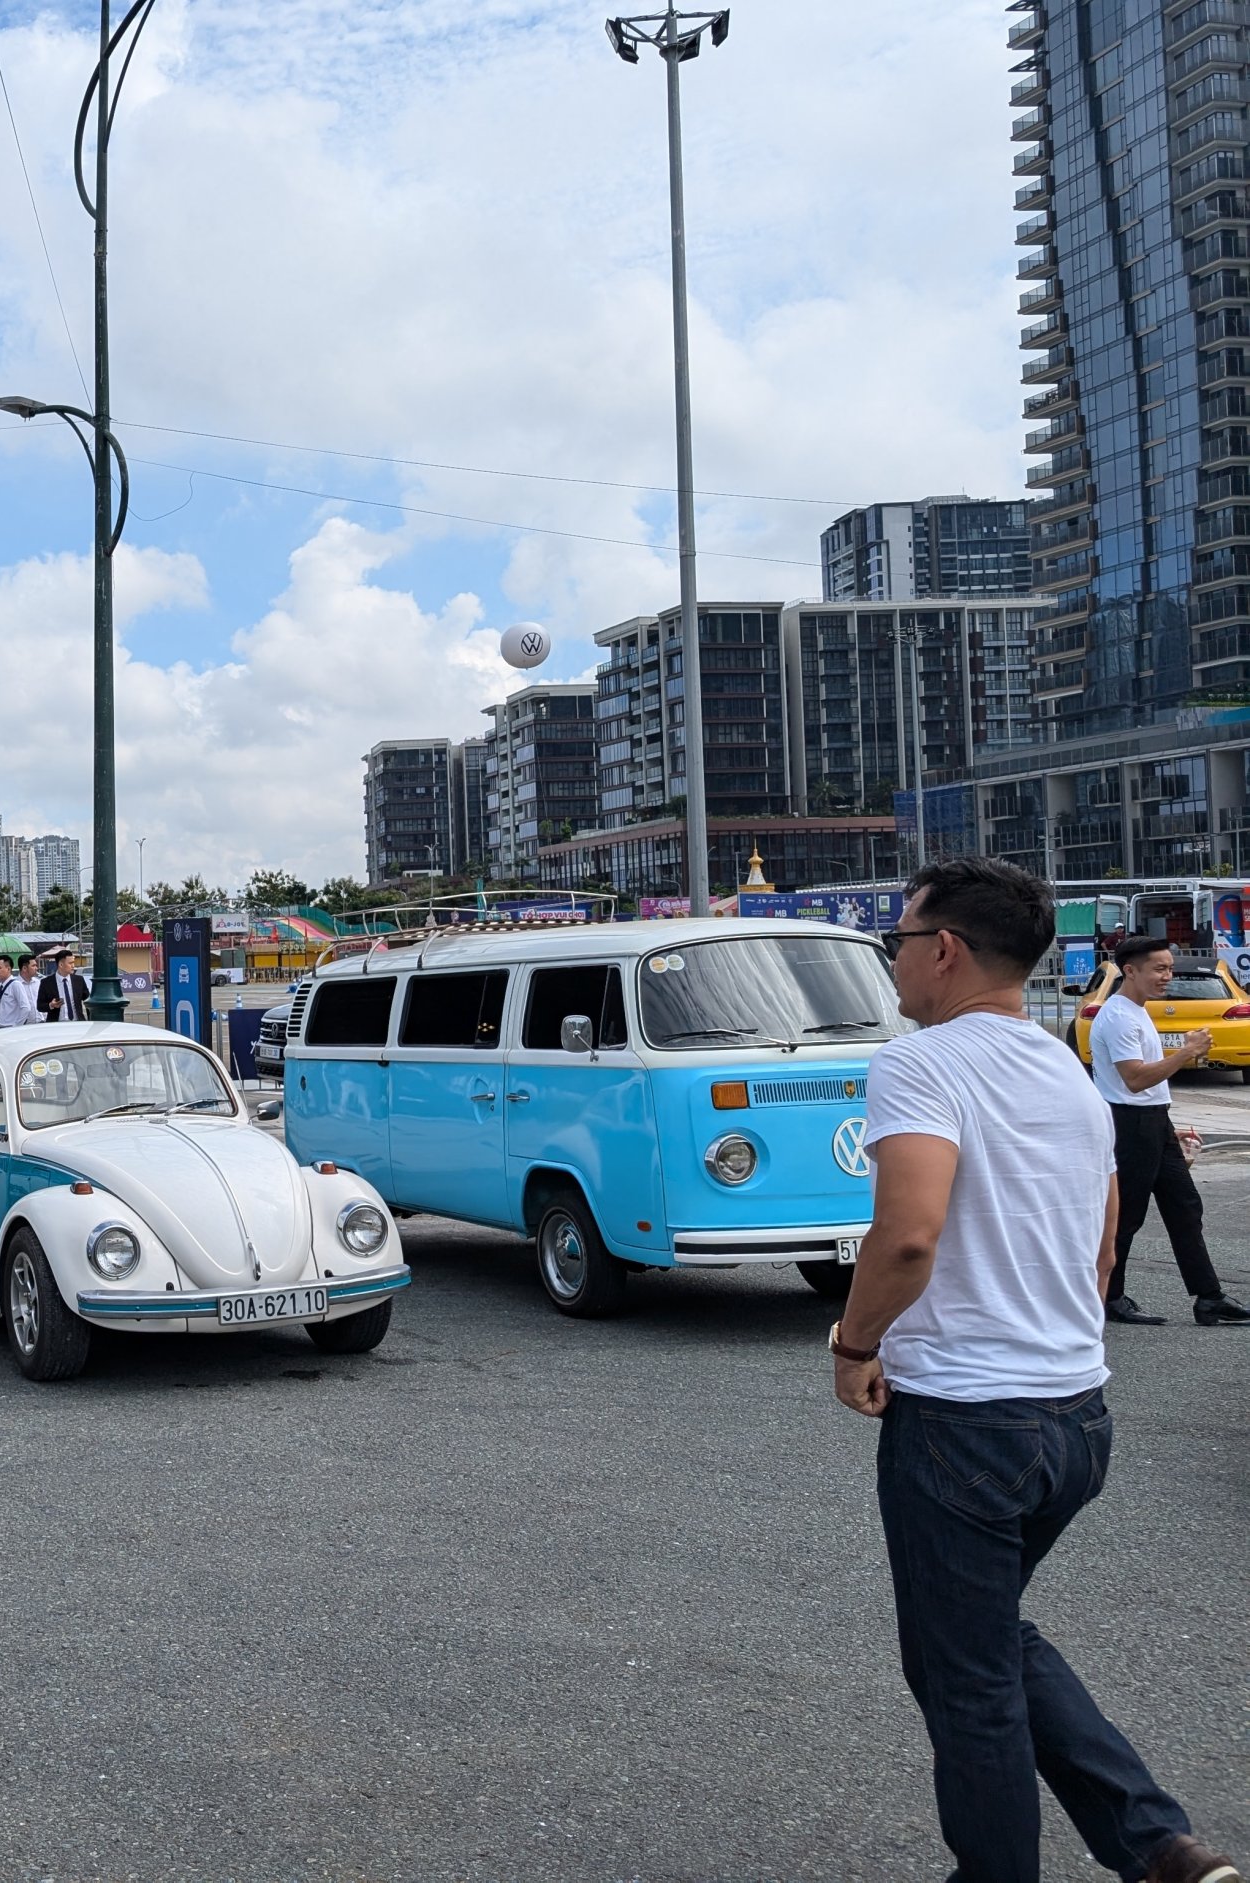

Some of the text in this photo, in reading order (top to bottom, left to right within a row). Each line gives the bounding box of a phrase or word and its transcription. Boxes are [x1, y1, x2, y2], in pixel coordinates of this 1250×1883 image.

[796, 907, 831, 916] PICKLEBALL
[1164, 1034, 1180, 1042] 61A
[222, 1289, 325, 1321] 30A-621.10
